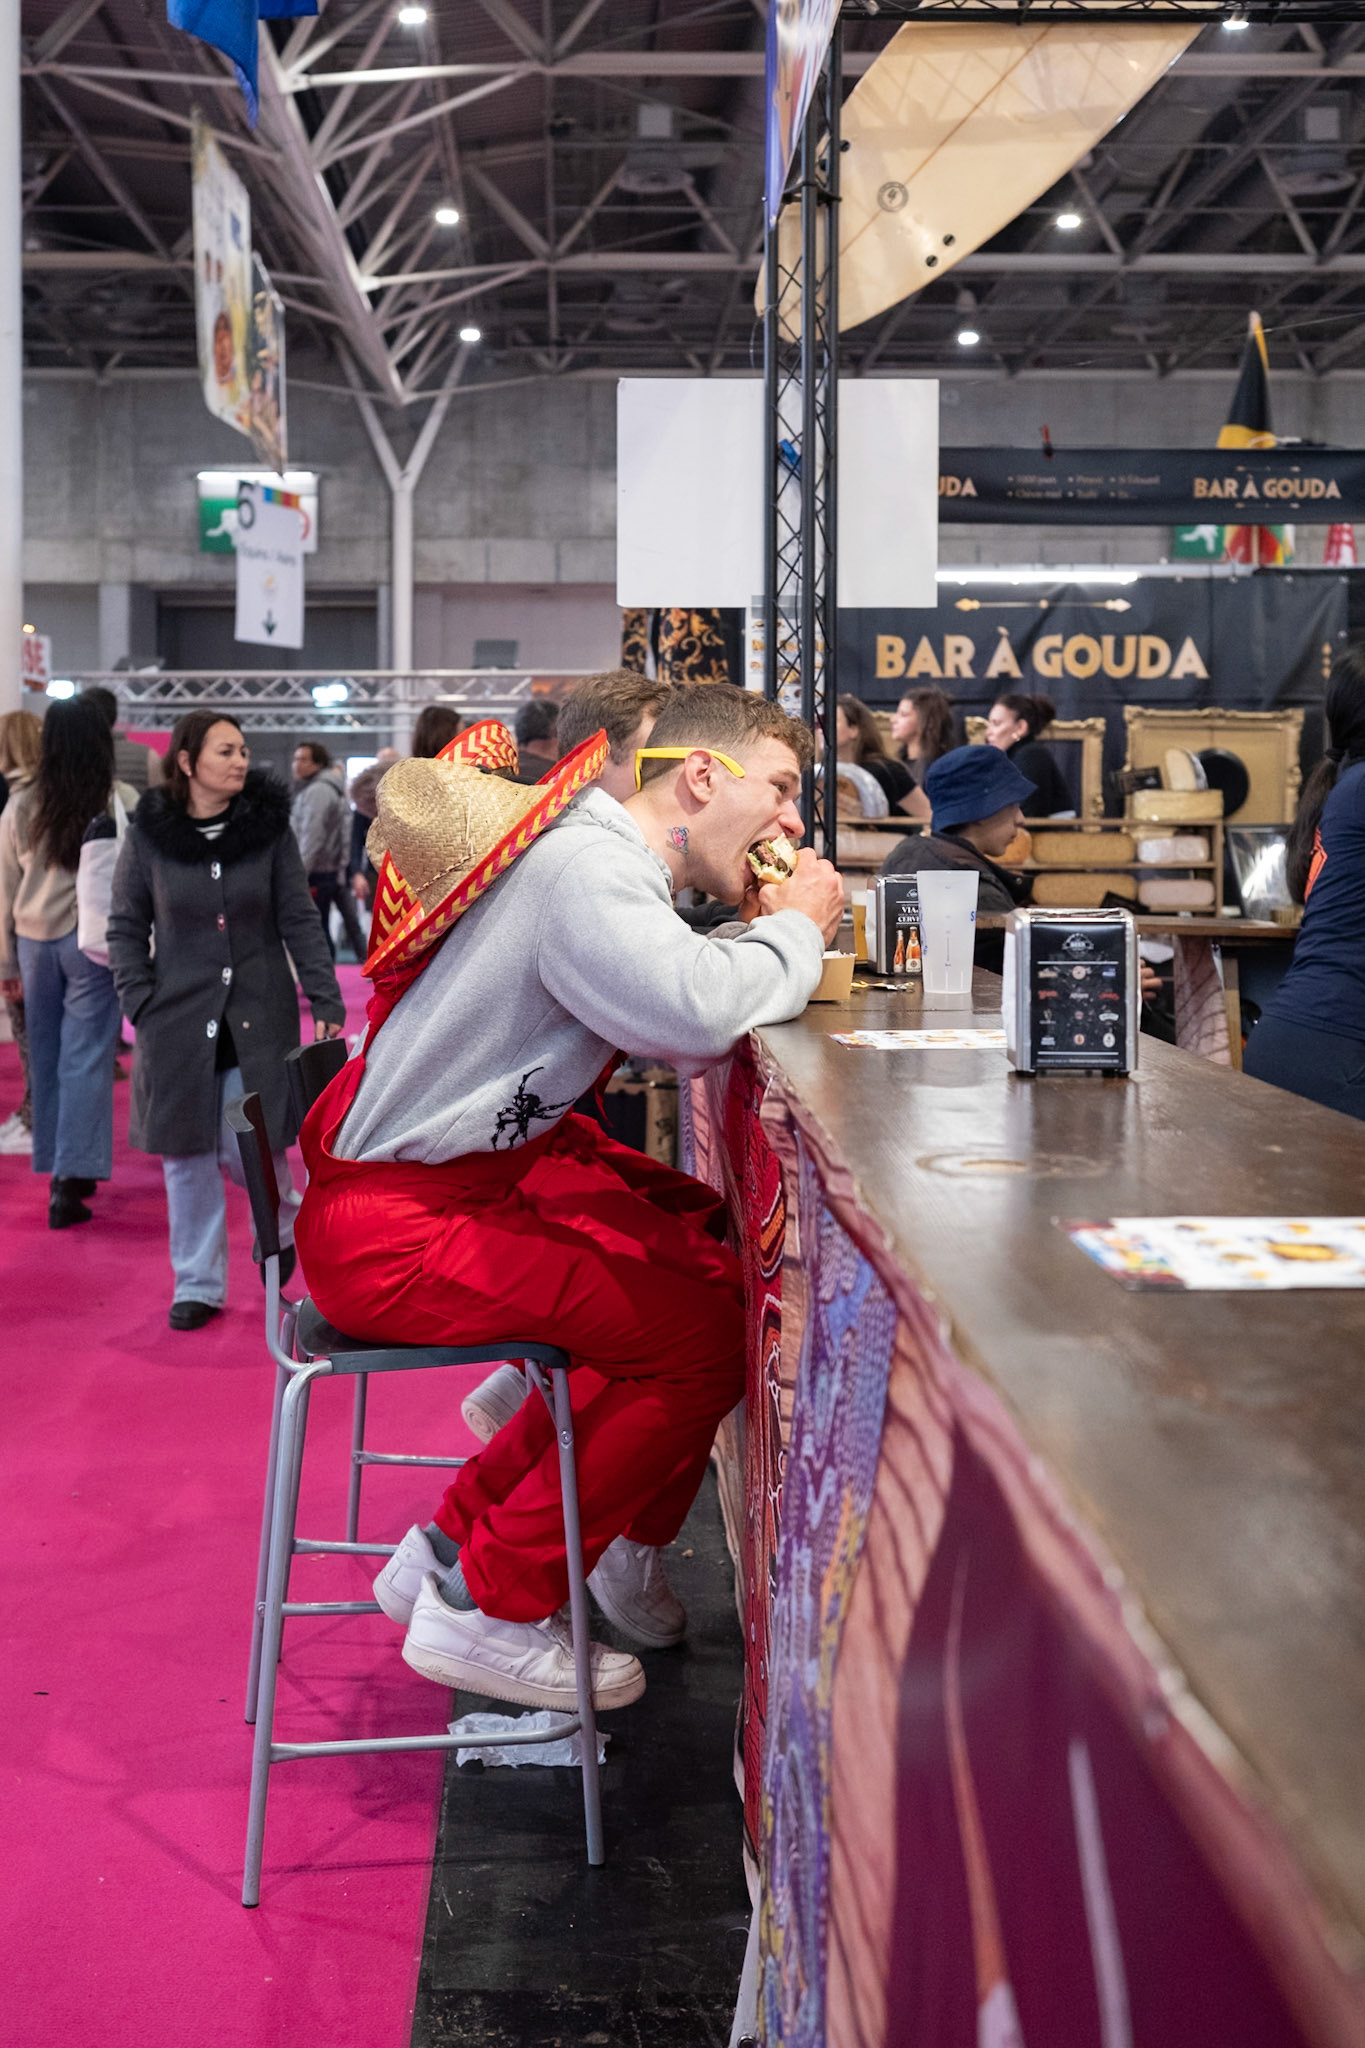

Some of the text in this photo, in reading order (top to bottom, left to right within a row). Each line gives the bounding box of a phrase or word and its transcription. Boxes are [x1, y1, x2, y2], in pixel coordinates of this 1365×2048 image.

[1193, 473, 1342, 499] BAR À GOUDA
[876, 626, 1211, 680] BAR À GOUDA
